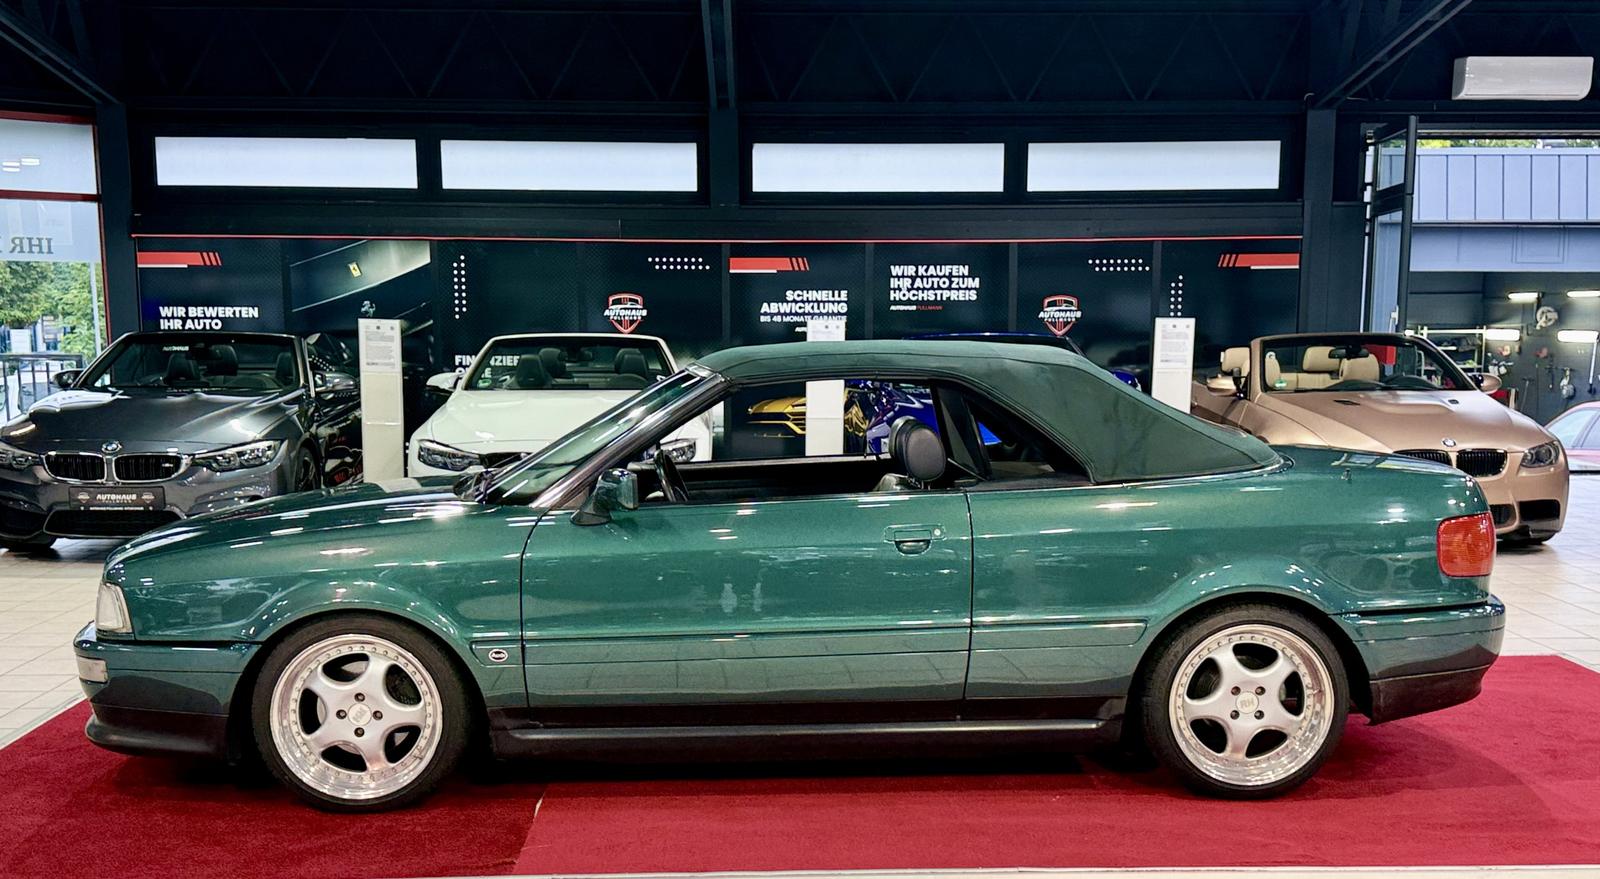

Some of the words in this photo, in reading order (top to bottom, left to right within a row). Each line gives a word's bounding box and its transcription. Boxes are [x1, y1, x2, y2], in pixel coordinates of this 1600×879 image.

[890, 265, 916, 276] WIR
[918, 265, 969, 276] KAUFEN
[890, 277, 911, 288] IHR
[914, 277, 949, 288] AUTO
[951, 277, 980, 288] ZUM
[785, 290, 848, 301] SCHNELLE
[890, 287, 978, 301] HÖCHSTPREIS
[159, 306, 186, 317] WIR
[188, 307, 259, 318] BEWERTEN
[760, 302, 848, 313] ABWICKLUNG
[160, 318, 183, 330] IHR
[184, 318, 222, 330] AUTO
